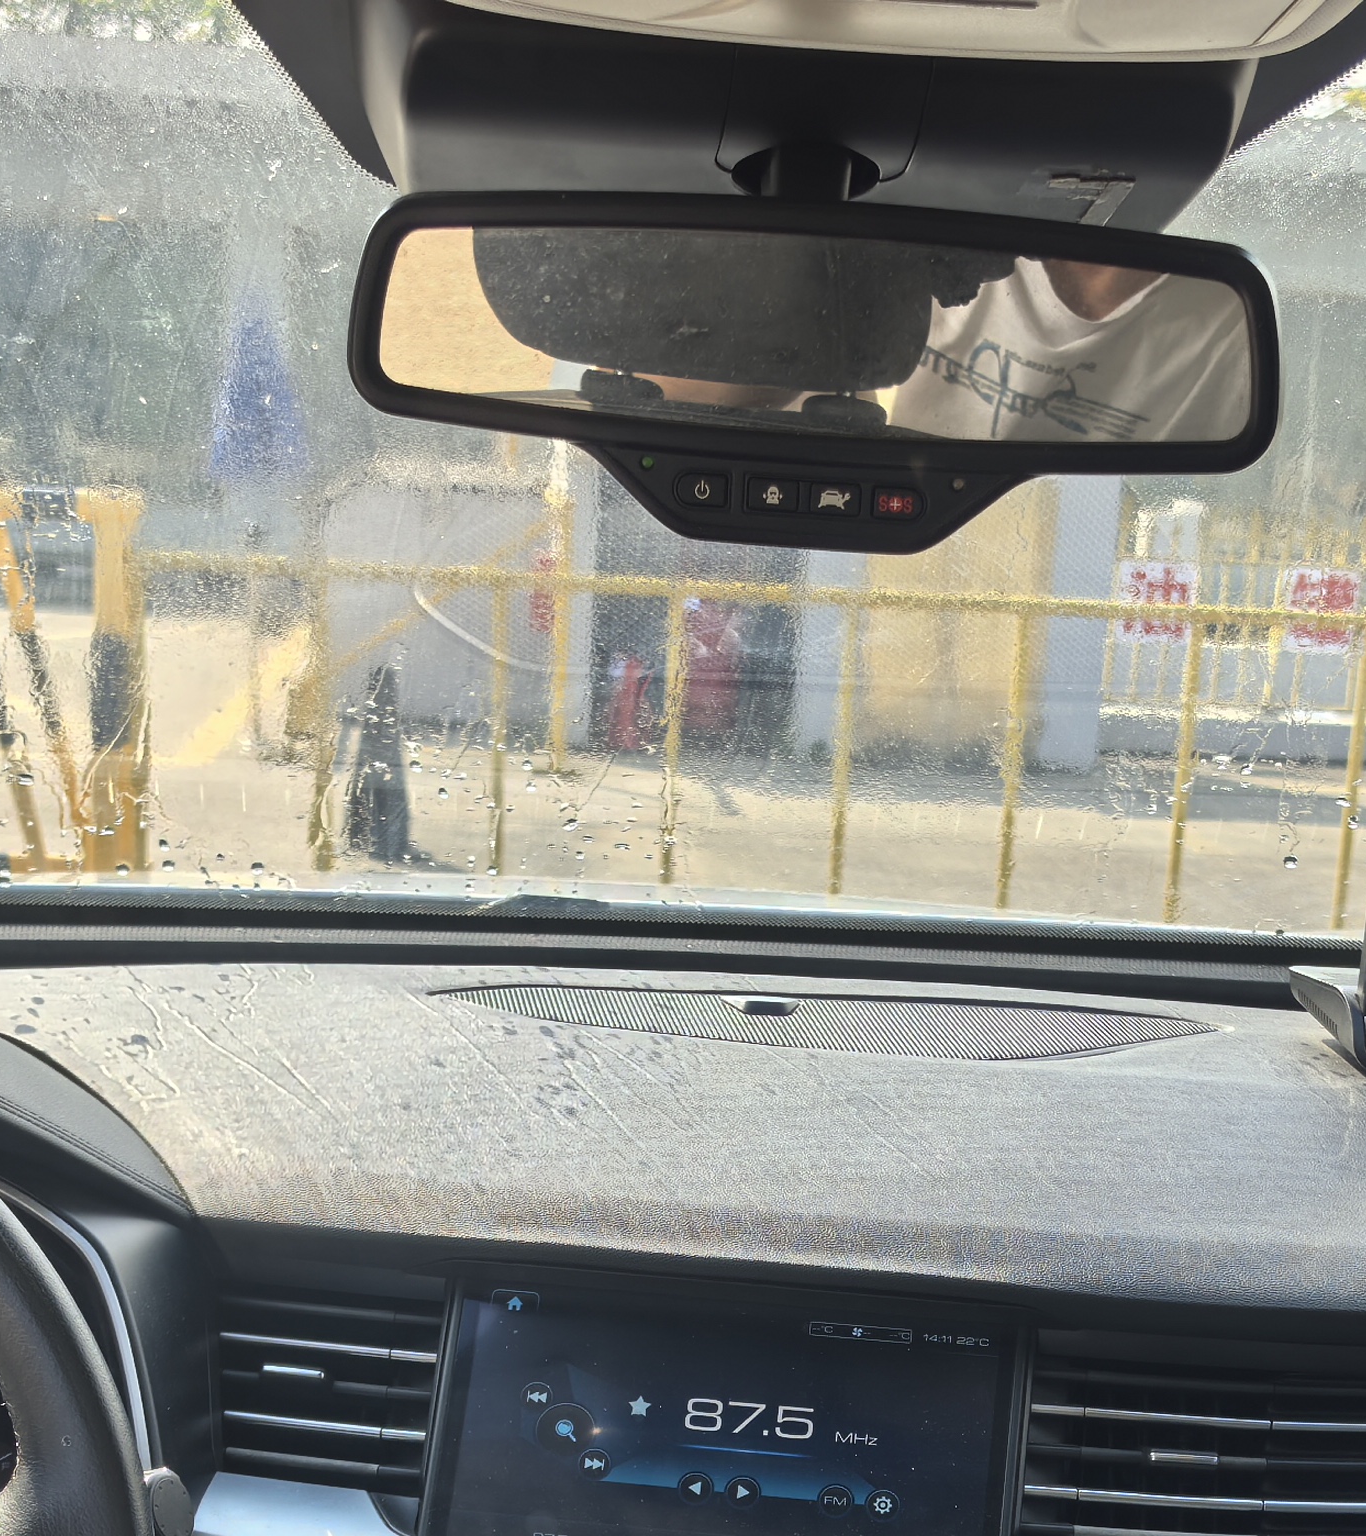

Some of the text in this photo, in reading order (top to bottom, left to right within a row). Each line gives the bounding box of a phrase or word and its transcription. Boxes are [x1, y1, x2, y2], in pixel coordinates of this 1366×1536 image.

[922, 1333, 990, 1347] 14:11 22°C
[684, 1398, 879, 1446] 87.5 MHz
[824, 1496, 847, 1506] FM
